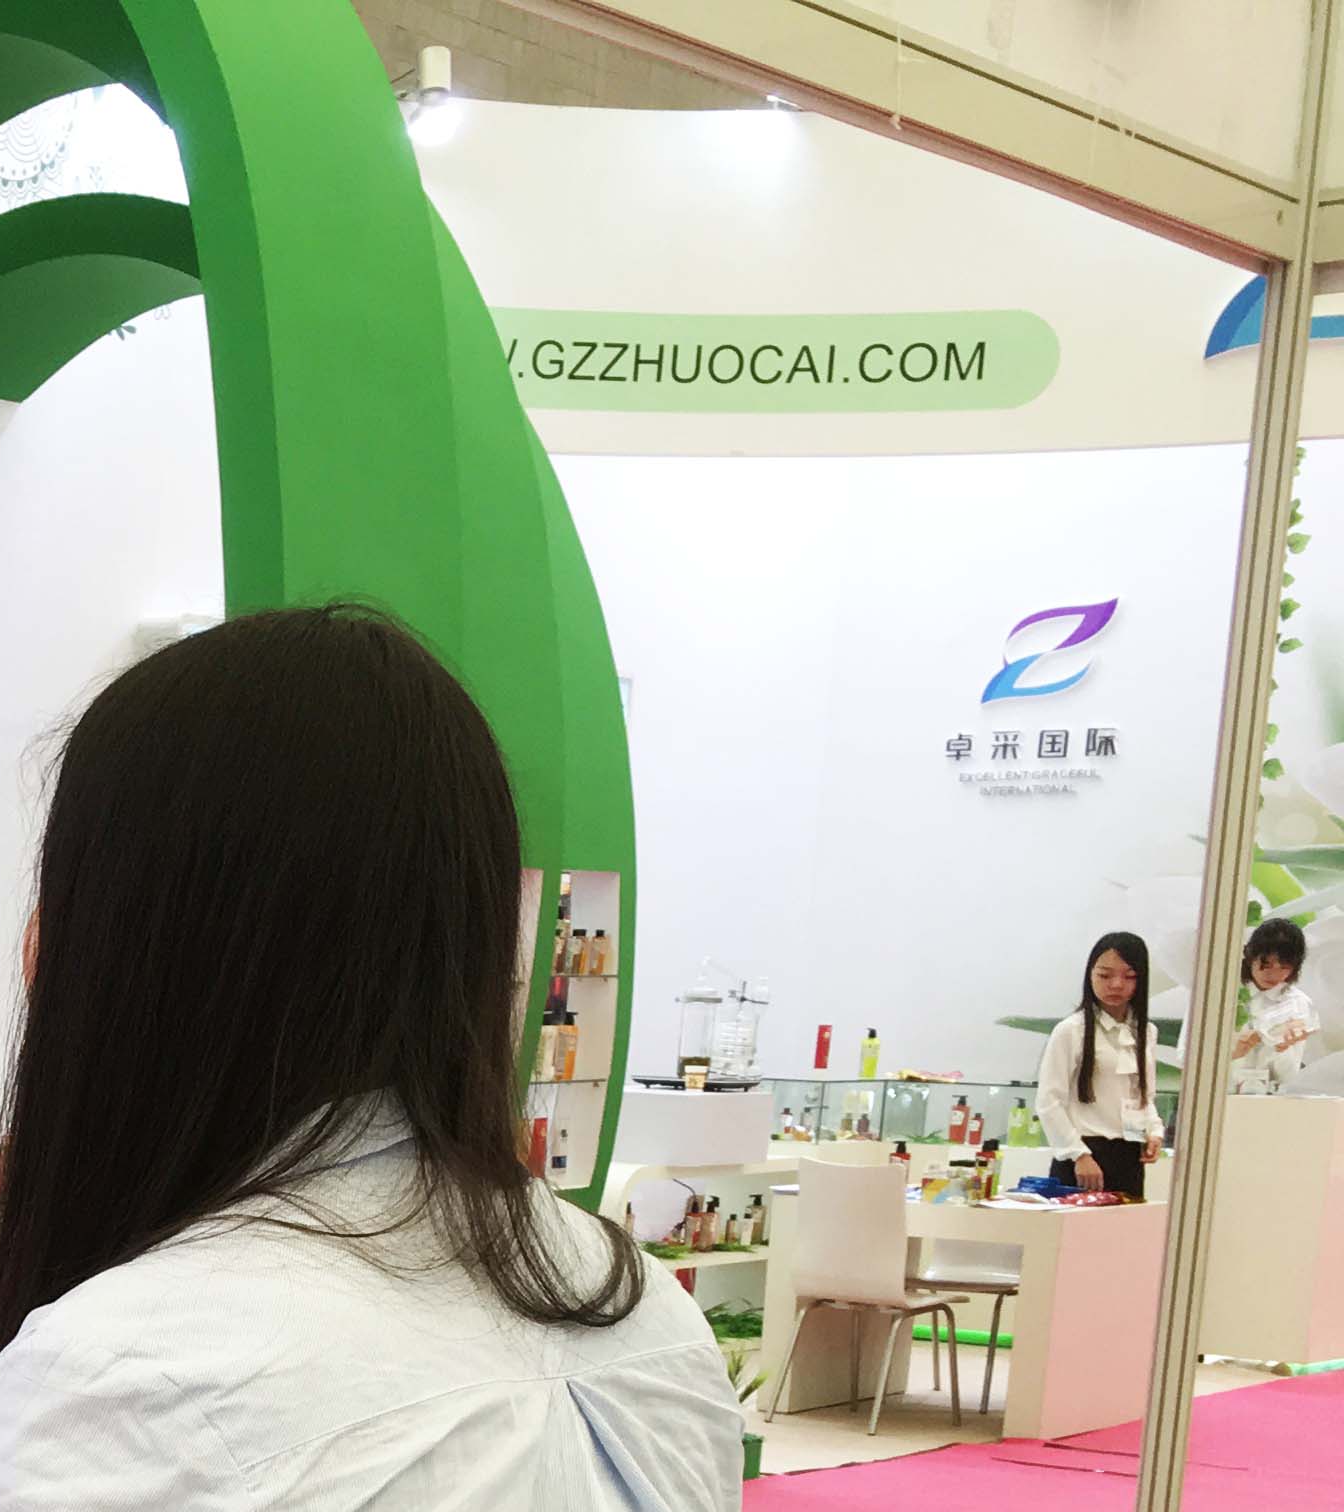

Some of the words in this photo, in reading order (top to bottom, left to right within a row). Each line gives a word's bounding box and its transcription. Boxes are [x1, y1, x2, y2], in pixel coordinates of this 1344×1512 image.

[506, 338, 988, 386] .GZZHUOCAI.COM
[945, 727, 1119, 761] 卓采国际
